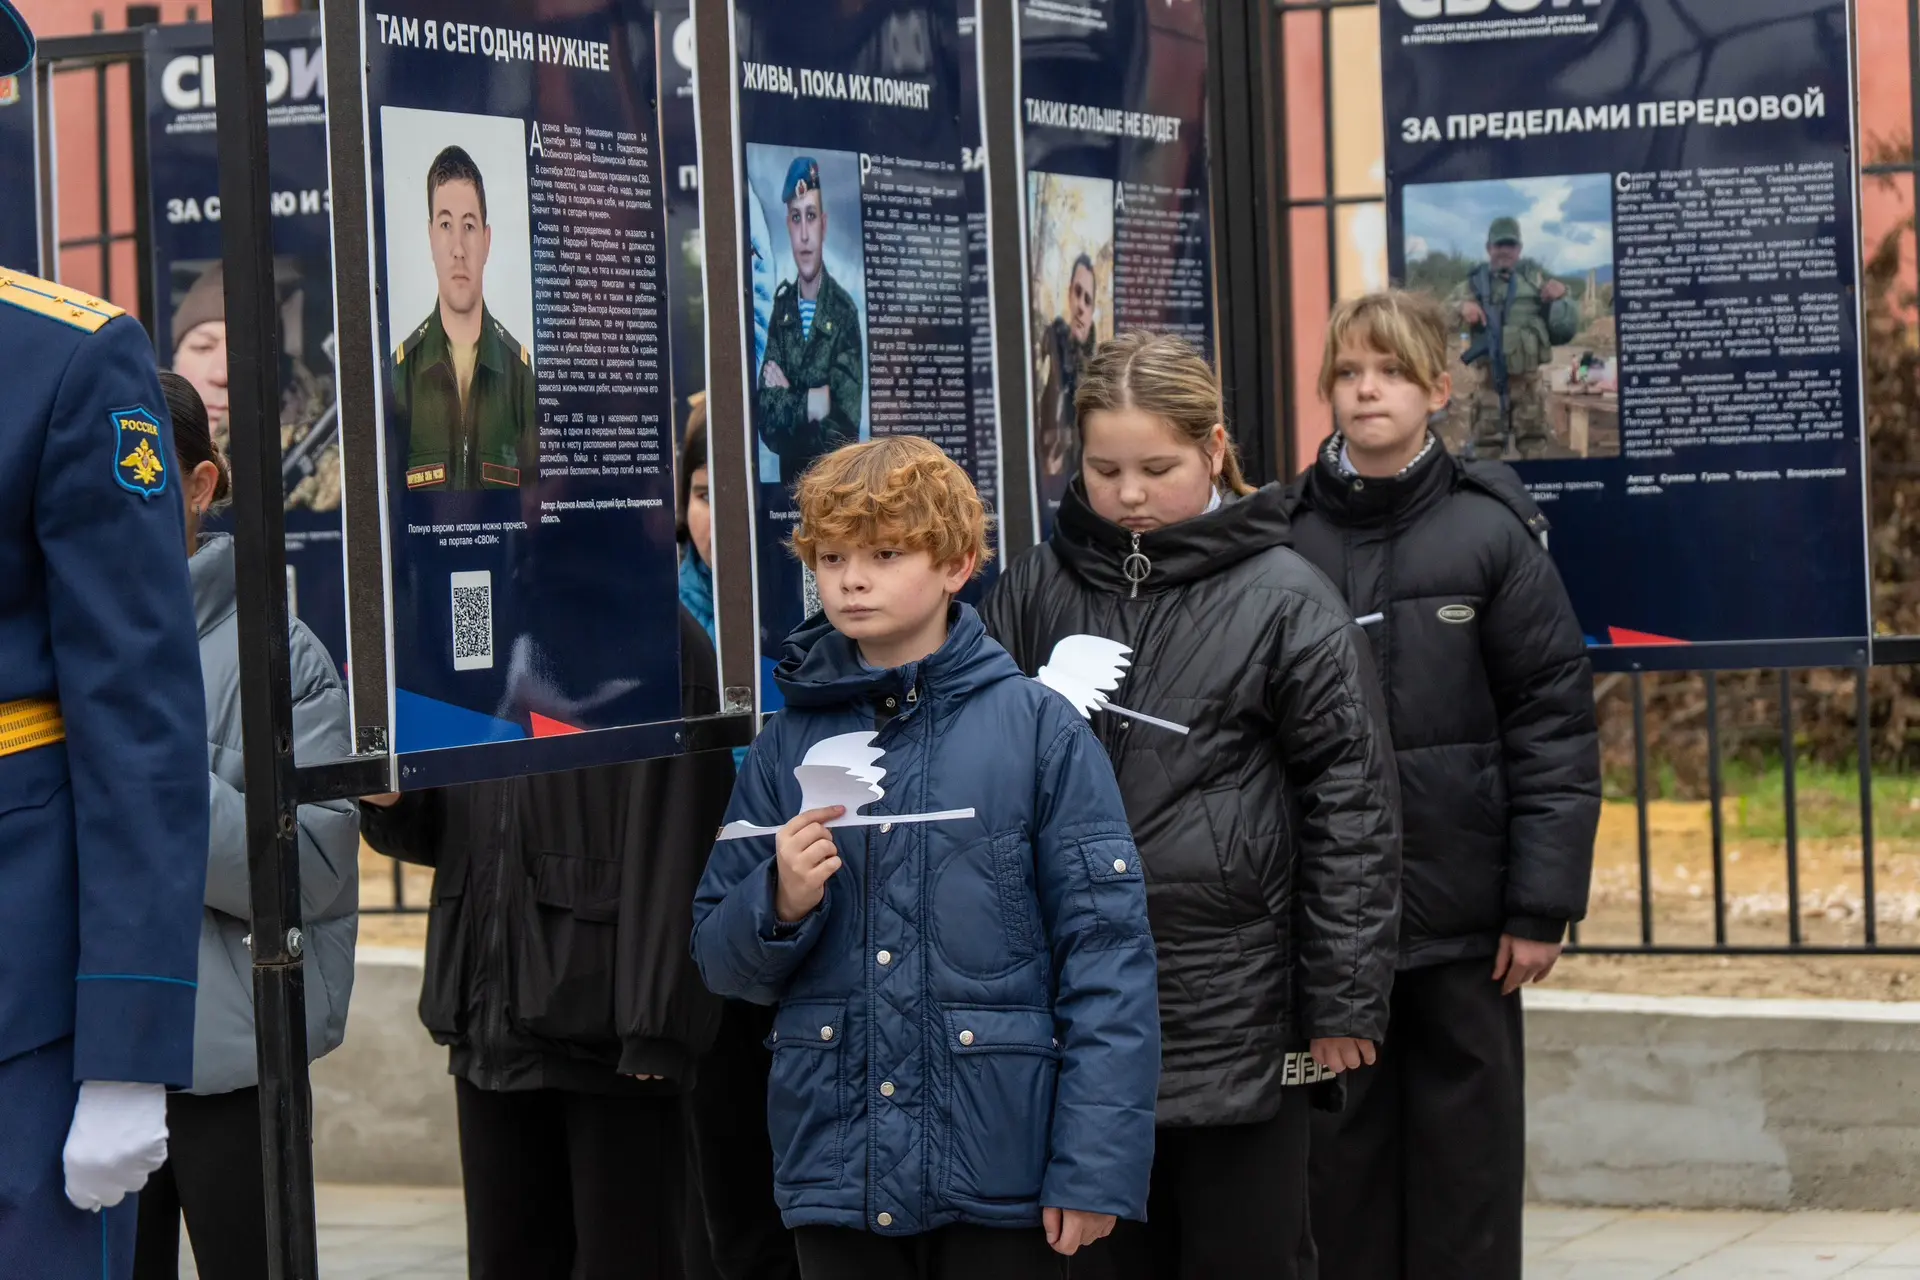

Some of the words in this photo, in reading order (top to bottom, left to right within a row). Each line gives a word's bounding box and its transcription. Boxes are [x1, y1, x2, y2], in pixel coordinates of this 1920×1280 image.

[1457, 15, 1547, 31] МЕЖНАЦИОНАЛЬНОЙ
[1549, 14, 1586, 24] ДРУЖБЫ
[1411, 34, 1445, 44] ПЕРИОД
[1447, 29, 1509, 42] СПЕЦИАЛЬНОЙ
[1511, 26, 1550, 37] ВОЕННОЙ
[1552, 23, 1598, 34] ОПЕРАЦИИ
[377, 14, 419, 48] ТАМ
[425, 20, 438, 50] Я
[443, 21, 535, 63] СЕГОДНЯ
[538, 33, 610, 71] НУЖНЕЕ
[743, 62, 798, 99] ЖИВЫ,
[801, 69, 847, 99] ПОКА
[850, 74, 872, 101] ИХ
[874, 77, 931, 110] ПОМНЯТ
[1025, 98, 1068, 126] ТАКИХ
[1069, 105, 1123, 133] БОЛЬШЕ
[1125, 112, 1141, 136] НЕ
[1143, 115, 1181, 142] БУДЕТ
[1401, 116, 1441, 143] ЗА
[1447, 104, 1630, 140] ПРЕДЕЛАМИ
[1638, 86, 1825, 127] ПЕРЕДОВОЙ
[564, 124, 581, 135] Виктор
[585, 127, 613, 138] Николаевич
[617, 132, 637, 140] родился
[543, 136, 565, 146] сентября
[570, 138, 581, 147] 1994
[586, 141, 596, 150] года
[617, 143, 648, 155] Рождествено
[543, 149, 572, 160] Собинского
[574, 152, 591, 162] района
[593, 154, 626, 165] Владимирской
[628, 157, 648, 167] области.
[540, 166, 563, 176] сентябре
[564, 168, 575, 176] 2022
[577, 170, 588, 178] года
[589, 170, 608, 180] Виктора
[609, 174, 631, 182] призвали
[639, 175, 650, 184] СВО.
[531, 178, 552, 189] Получив
[555, 181, 578, 192] повестку,
[588, 184, 605, 192] сказал:
[608, 185, 618, 193] «Раз
[621, 187, 633, 196] надо,
[167, 198, 202, 224] ЗА
[301, 189, 320, 214] И
[532, 193, 545, 202] надо.
[556, 193, 567, 203] буду
[573, 196, 595, 206] позорить
[604, 197, 617, 207] себя,
[626, 200, 652, 210] родителей.
[532, 204, 550, 214] Значит
[568, 208, 587, 218] сегодня
[589, 211, 611, 219] нужнее».
[554, 414, 568, 424] марта
[572, 413, 583, 422] 2025
[587, 414, 598, 423] года
[642, 415, 658, 424] пункта
[120, 420, 158, 435] РОССИЯ
[540, 427, 562, 436] Залиман,
[568, 428, 583, 436] одном
[592, 428, 616, 436] очередных
[618, 427, 635, 435] боевых
[637, 426, 658, 436] заданий,
[548, 442, 560, 450] пути
[583, 441, 616, 450] расположения
[619, 441, 638, 449] раненых
[641, 441, 659, 449] солдат,
[540, 453, 568, 462] автомобиль
[574, 453, 588, 462] бойца
[603, 454, 631, 462] напарником
[541, 467, 568, 477] украинский
[570, 466, 600, 476] беспилотник,
[602, 466, 618, 476] Виктор
[620, 464, 634, 475] погиб
[643, 466, 659, 474] месте.
[541, 501, 555, 511] Автор:
[557, 501, 575, 511] Арсенов
[576, 499, 595, 510] Алексей,
[596, 498, 614, 509] средний
[615, 498, 627, 508] брат,
[627, 498, 662, 508] Владимирская
[541, 514, 560, 523] область.
[408, 524, 430, 535] Полную
[432, 524, 454, 534] версию
[456, 523, 480, 533] истории
[482, 522, 501, 530] можно
[503, 521, 527, 532] прочесть
[449, 537, 472, 547] портале
[474, 535, 499, 545] «СВОИ»:
